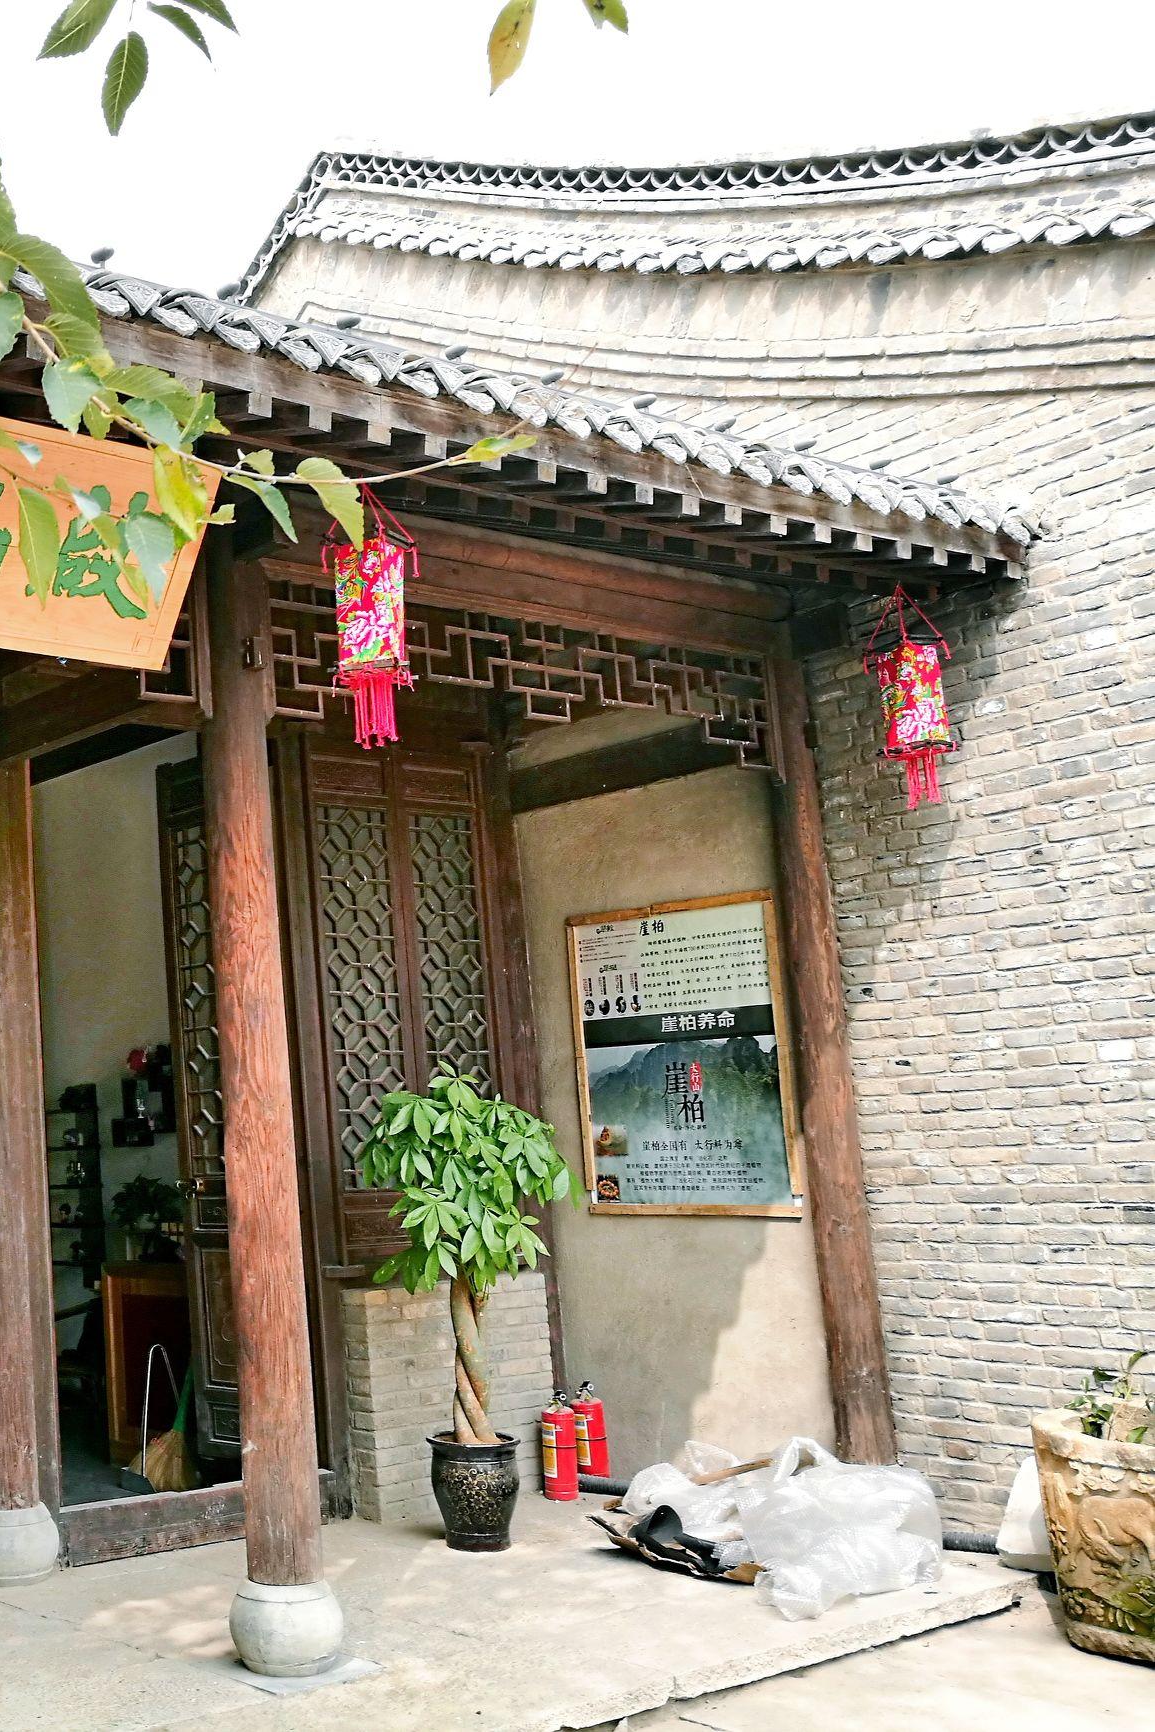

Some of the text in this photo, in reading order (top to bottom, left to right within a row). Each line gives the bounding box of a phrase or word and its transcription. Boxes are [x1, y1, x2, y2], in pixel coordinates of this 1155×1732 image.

[639, 919, 664, 937] 崖柏
[661, 1010, 735, 1033] 崖柏养命
[661, 1061, 705, 1123] 崖柏
